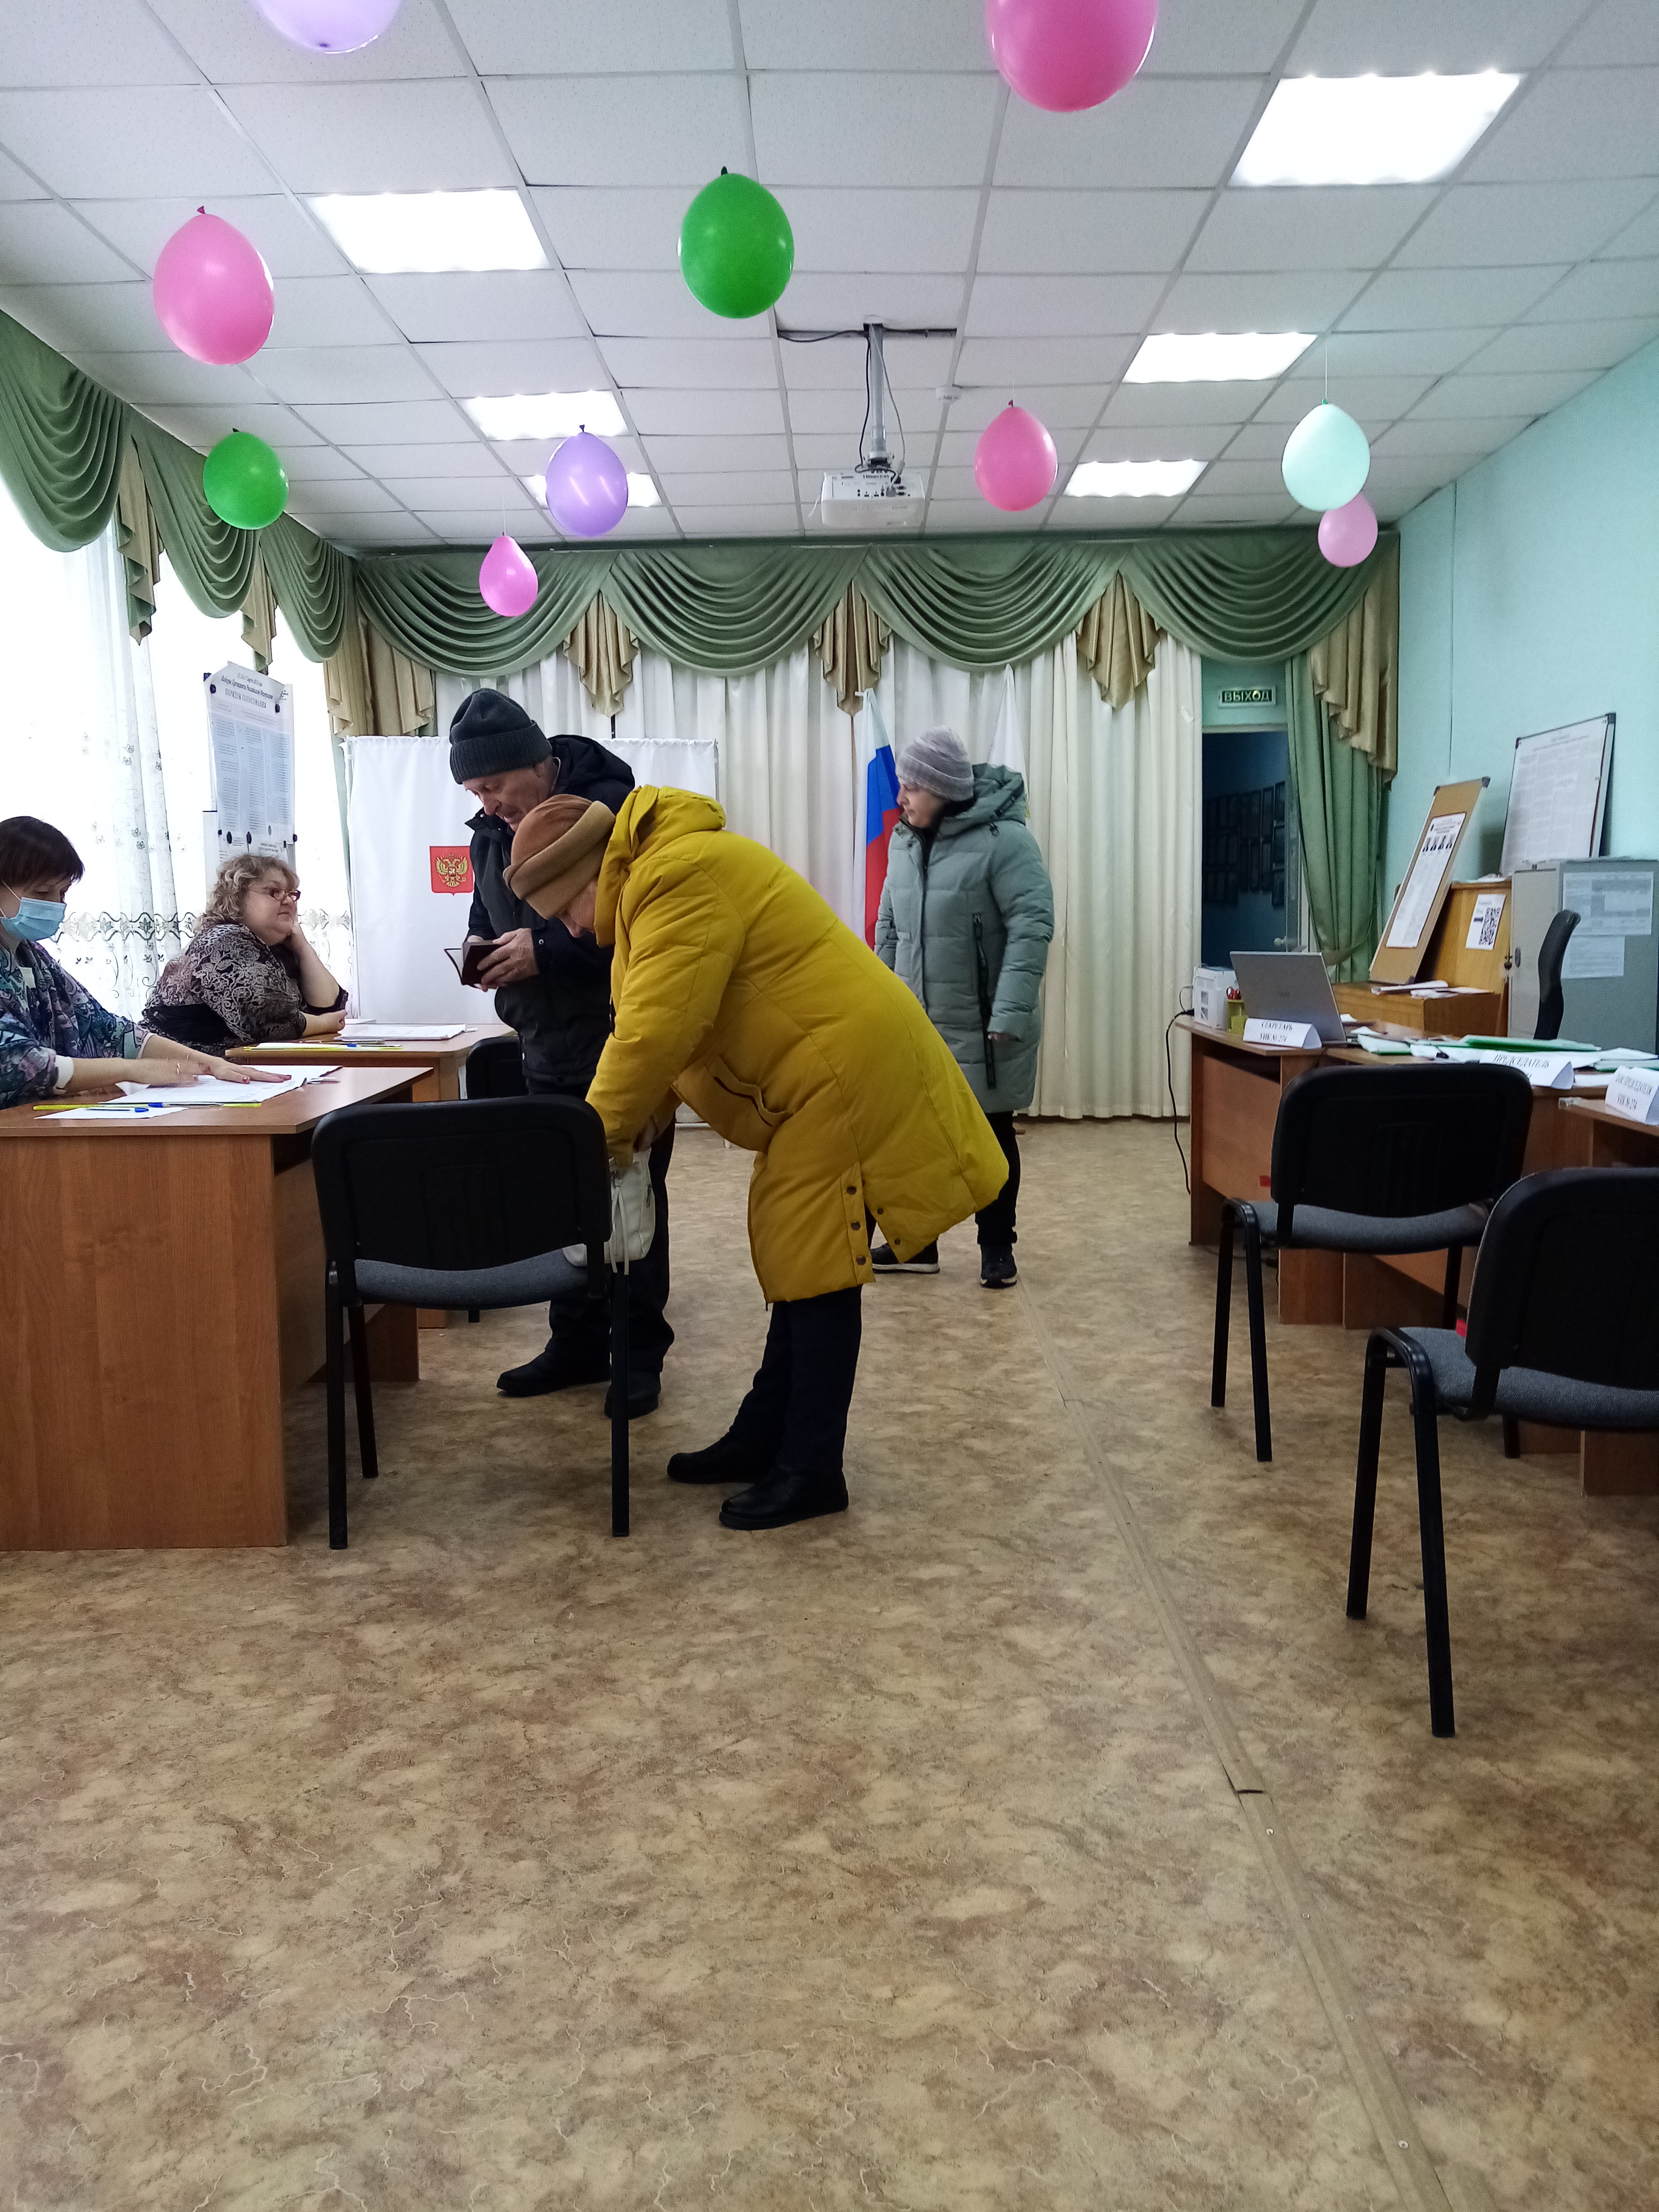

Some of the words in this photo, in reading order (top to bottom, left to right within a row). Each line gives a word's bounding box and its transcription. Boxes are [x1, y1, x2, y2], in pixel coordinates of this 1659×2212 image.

[1225, 690, 1270, 702] ВЫХОД
[1261, 1022, 1293, 1030] СЕКРЕТАРЬ
[1494, 1054, 1549, 1069] ПРЕДСЕДАТЕЛЬ
